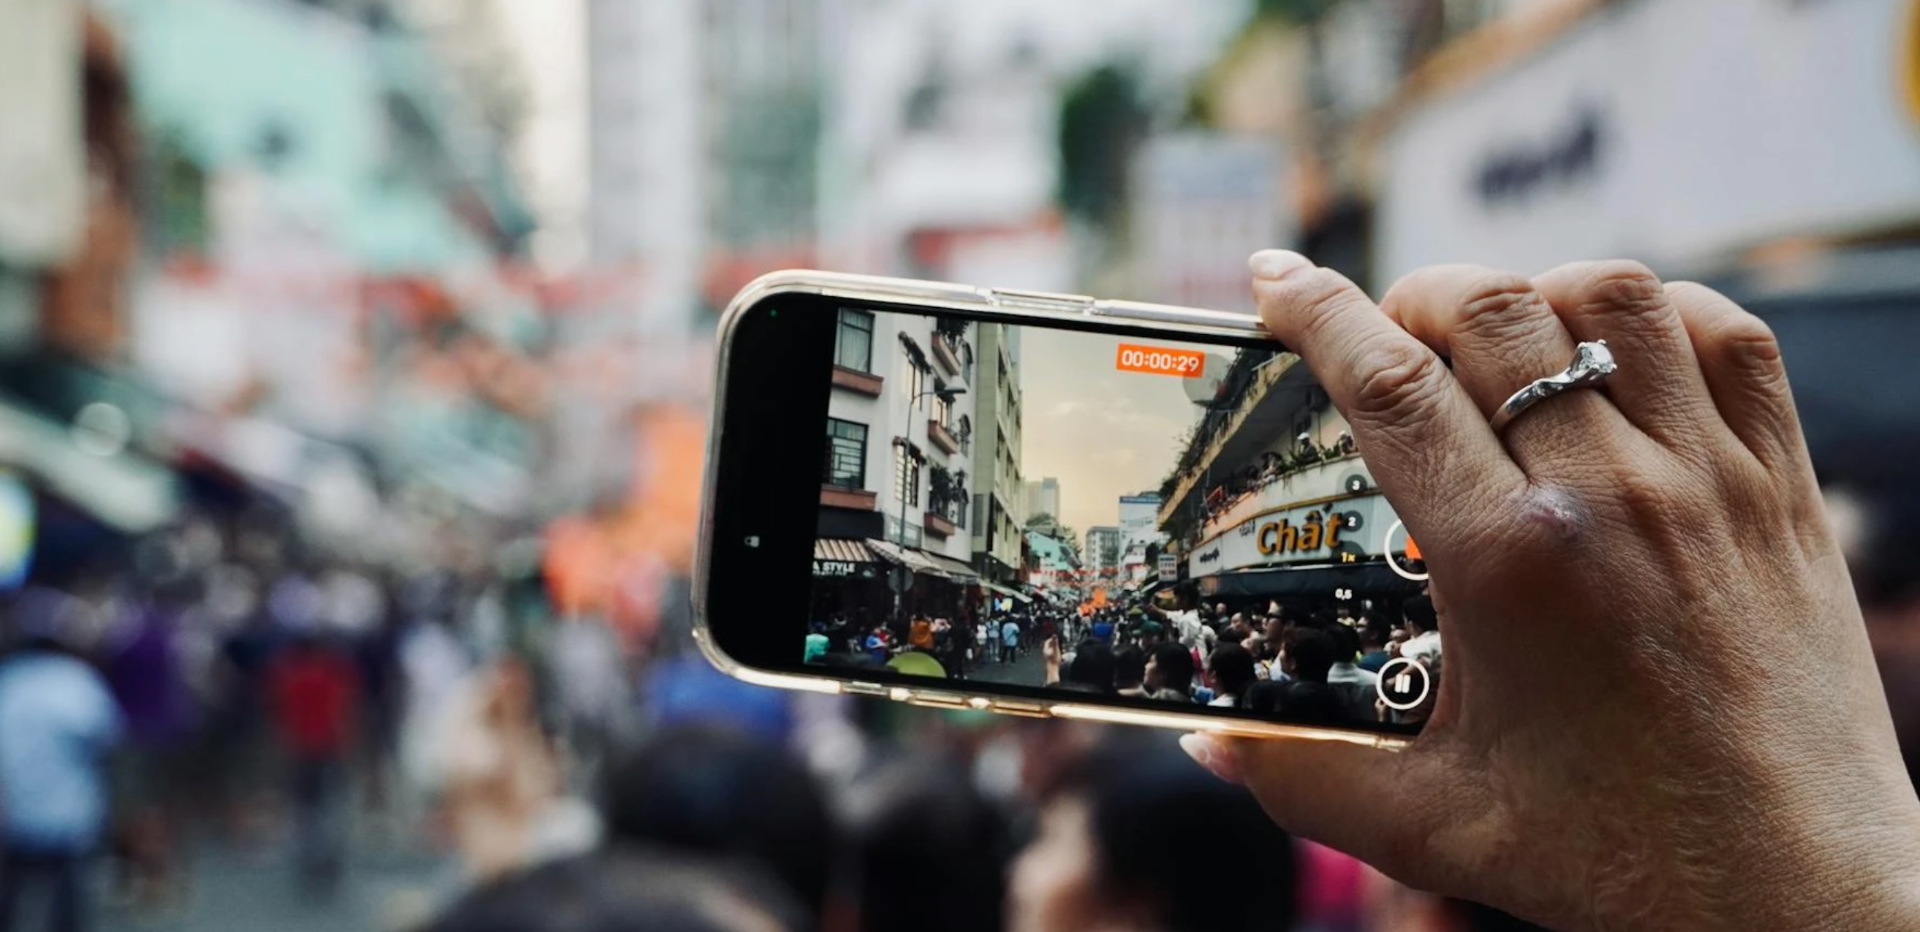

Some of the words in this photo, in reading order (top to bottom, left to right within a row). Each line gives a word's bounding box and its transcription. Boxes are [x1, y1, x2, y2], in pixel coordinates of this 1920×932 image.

[1121, 349, 1200, 372] 00:00:29
[1352, 479, 1360, 490] 3
[1348, 516, 1356, 527] 2
[1257, 503, 1342, 555] Chất
[823, 562, 855, 573] STYLE
